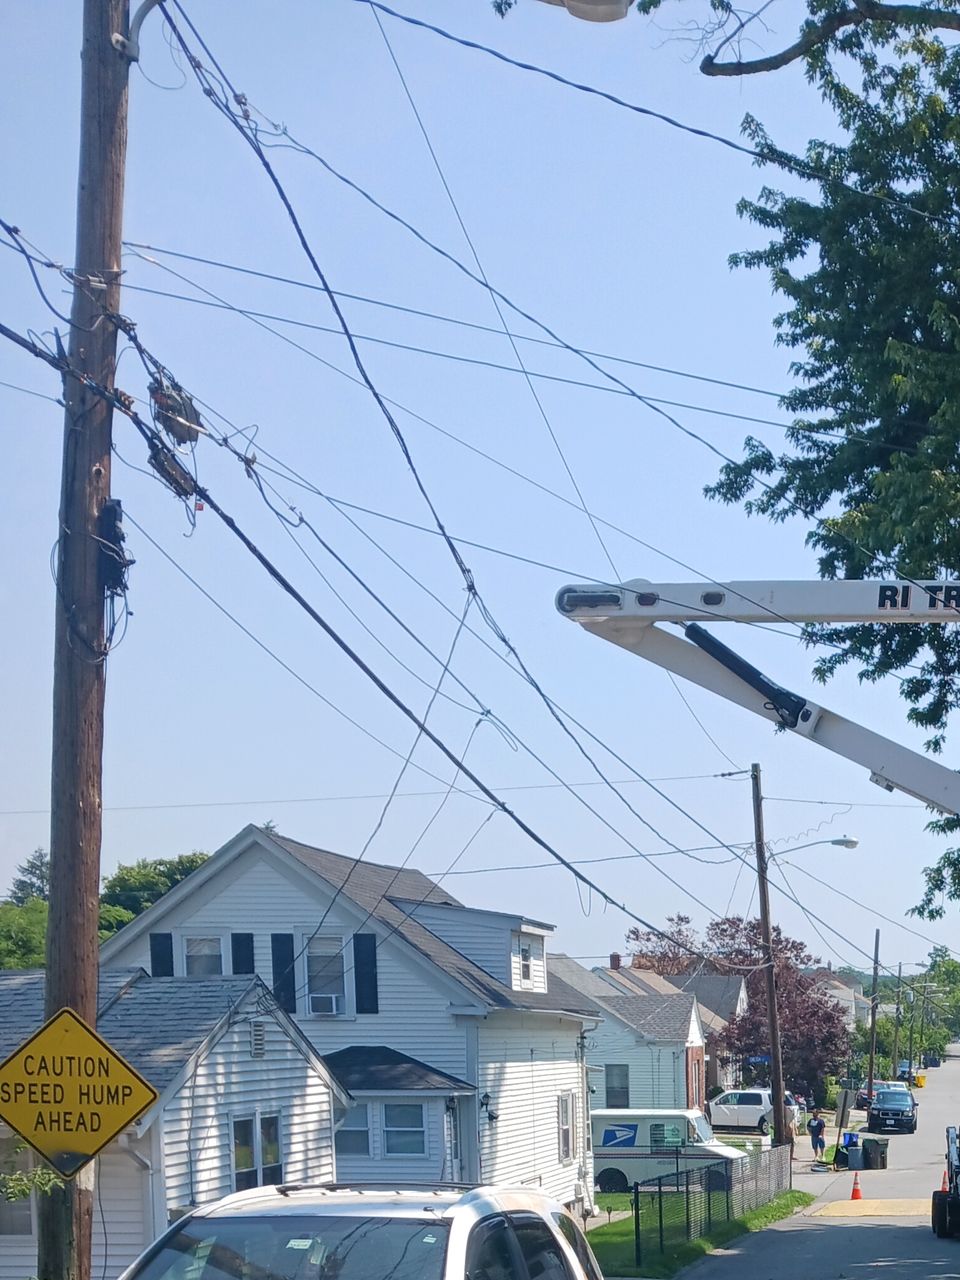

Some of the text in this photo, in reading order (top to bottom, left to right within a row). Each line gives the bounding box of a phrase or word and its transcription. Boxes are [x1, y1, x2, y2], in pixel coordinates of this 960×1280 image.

[878, 585, 910, 610] RI
[24, 1055, 110, 1077] CAUTION
[0, 1083, 134, 1106] SPEED HUMP
[34, 1111, 102, 1133] AHEAD
